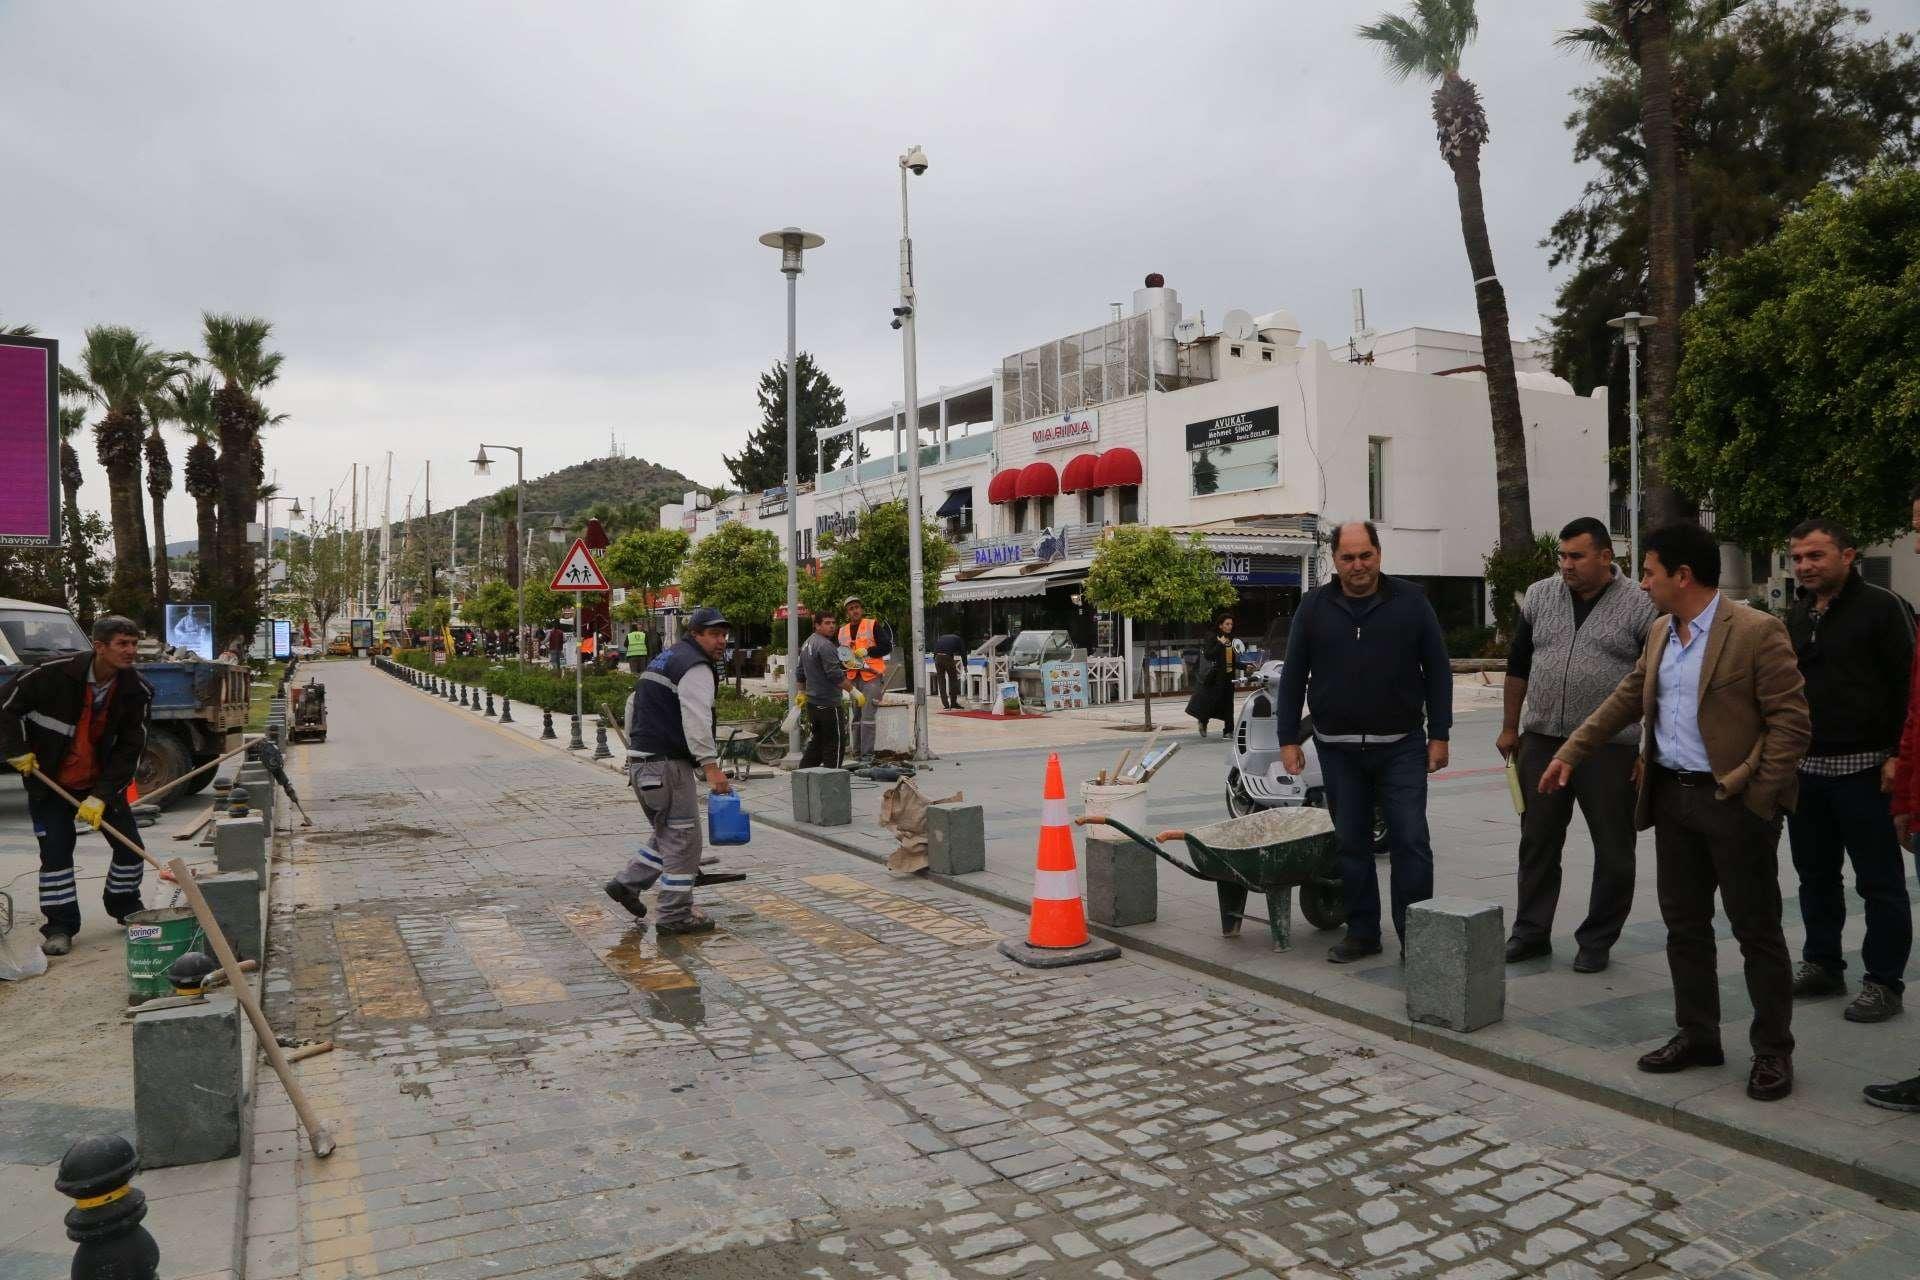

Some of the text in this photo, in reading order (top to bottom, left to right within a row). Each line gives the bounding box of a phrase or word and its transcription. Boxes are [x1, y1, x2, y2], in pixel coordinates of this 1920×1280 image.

[1215, 415, 1246, 429] AVUKAT
[1032, 420, 1090, 443] MARINA
[1209, 428, 1232, 439] Mehmet
[0, 536, 49, 546] havizyon
